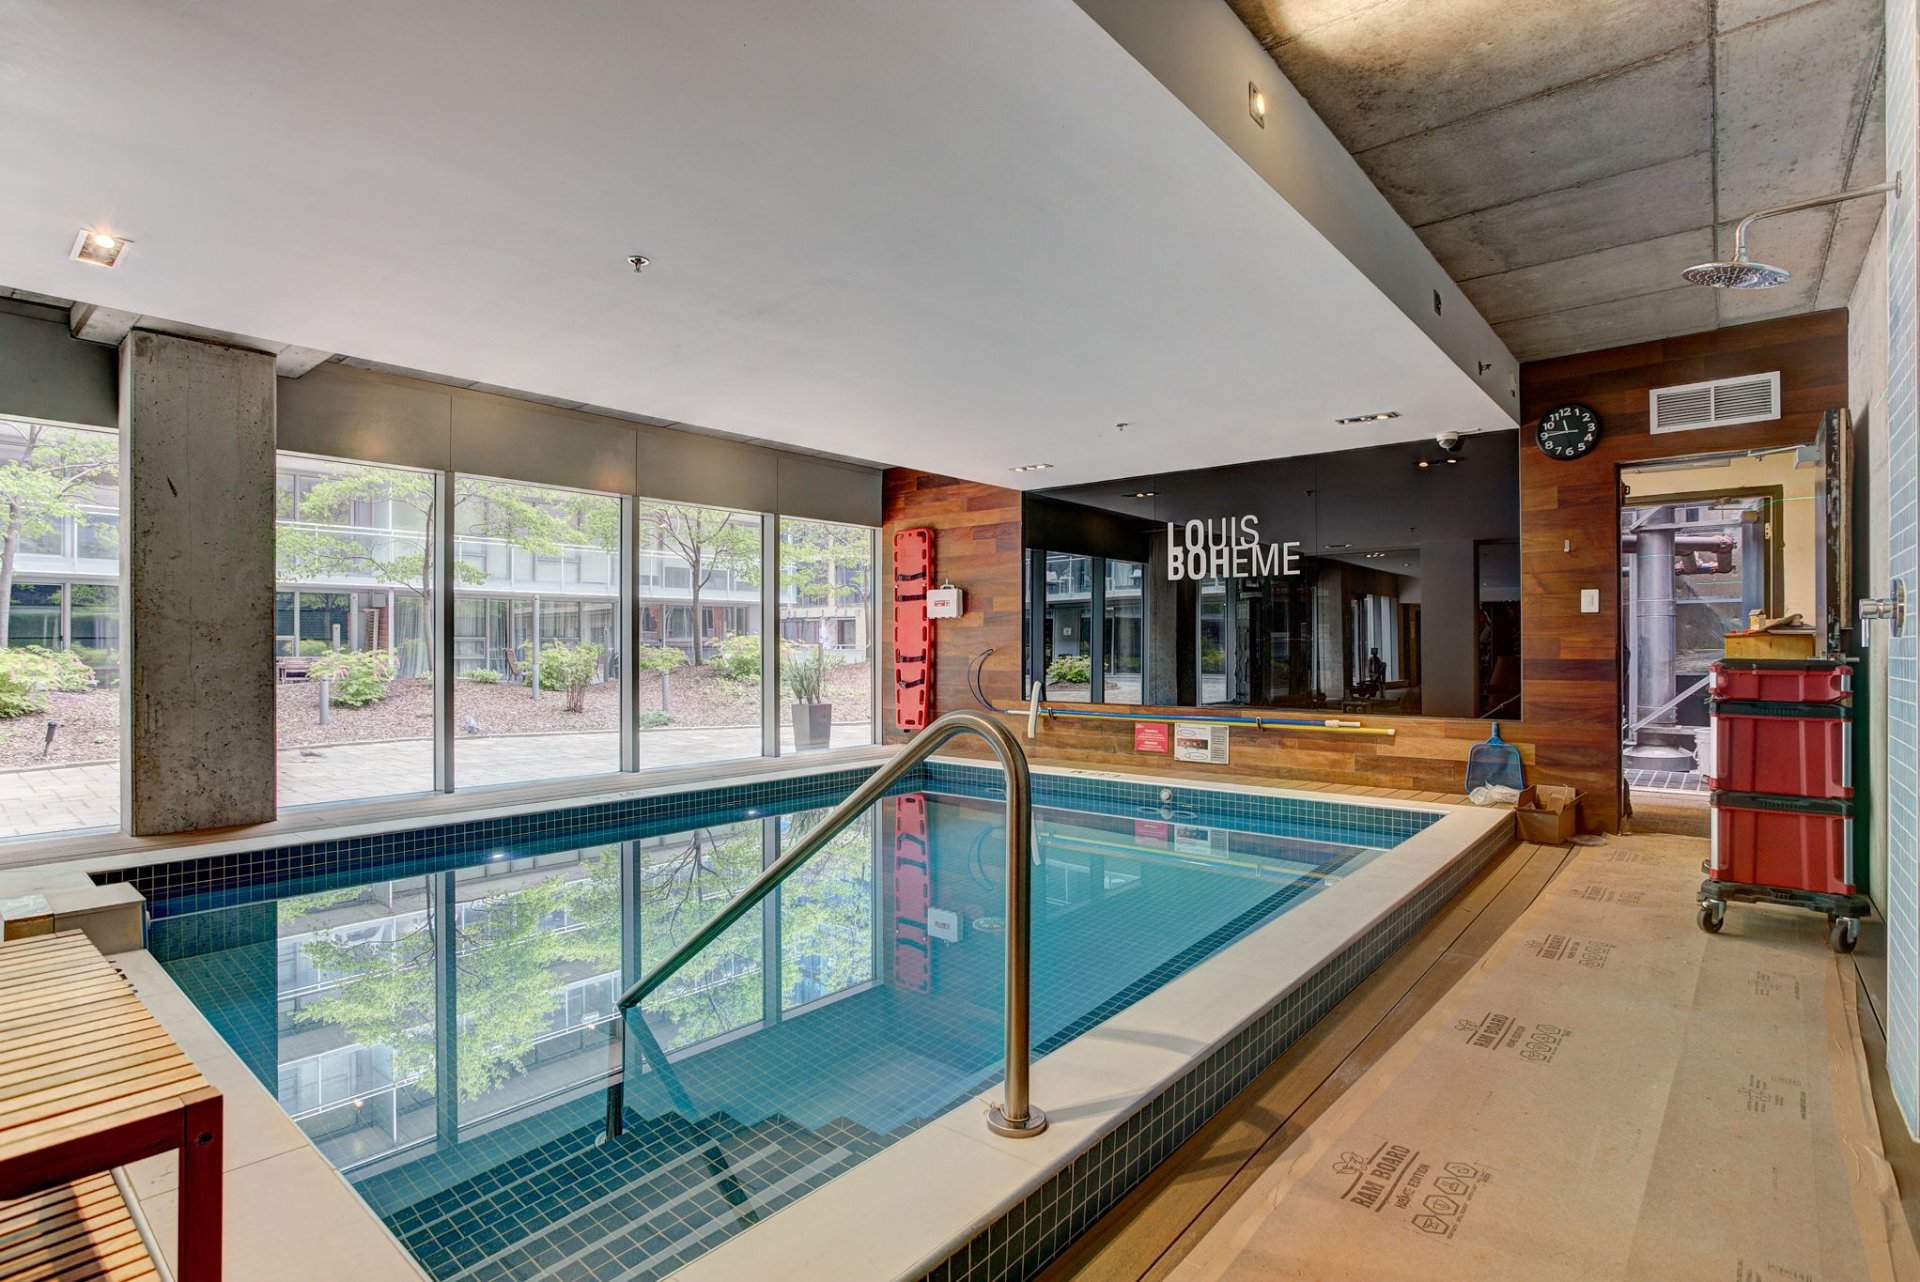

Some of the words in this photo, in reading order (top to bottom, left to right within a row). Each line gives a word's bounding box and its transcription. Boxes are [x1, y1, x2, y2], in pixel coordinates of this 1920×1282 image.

[1559, 407, 1572, 417] 12
[1574, 408, 1580, 417] 1
[1549, 413, 1560, 421] 11
[1582, 413, 1591, 421] 2
[1542, 421, 1555, 431] 10
[1587, 422, 1596, 432] 3
[1540, 432, 1549, 440] 9
[1583, 433, 1593, 442] 4
[1544, 441, 1554, 450] 8
[1577, 442, 1586, 451] 5
[1554, 446, 1562, 455] 7
[1565, 447, 1574, 456] 6
[1167, 514, 1260, 552] LOUIS
[1167, 541, 1301, 581] BOHEME
[1483, 1014, 1509, 1036] BOARD
[1473, 1033, 1496, 1048] RAM
[1350, 1180, 1385, 1208] RAM
[1371, 1144, 1411, 1181] BOARD
[1407, 1163, 1431, 1188] EDITION
